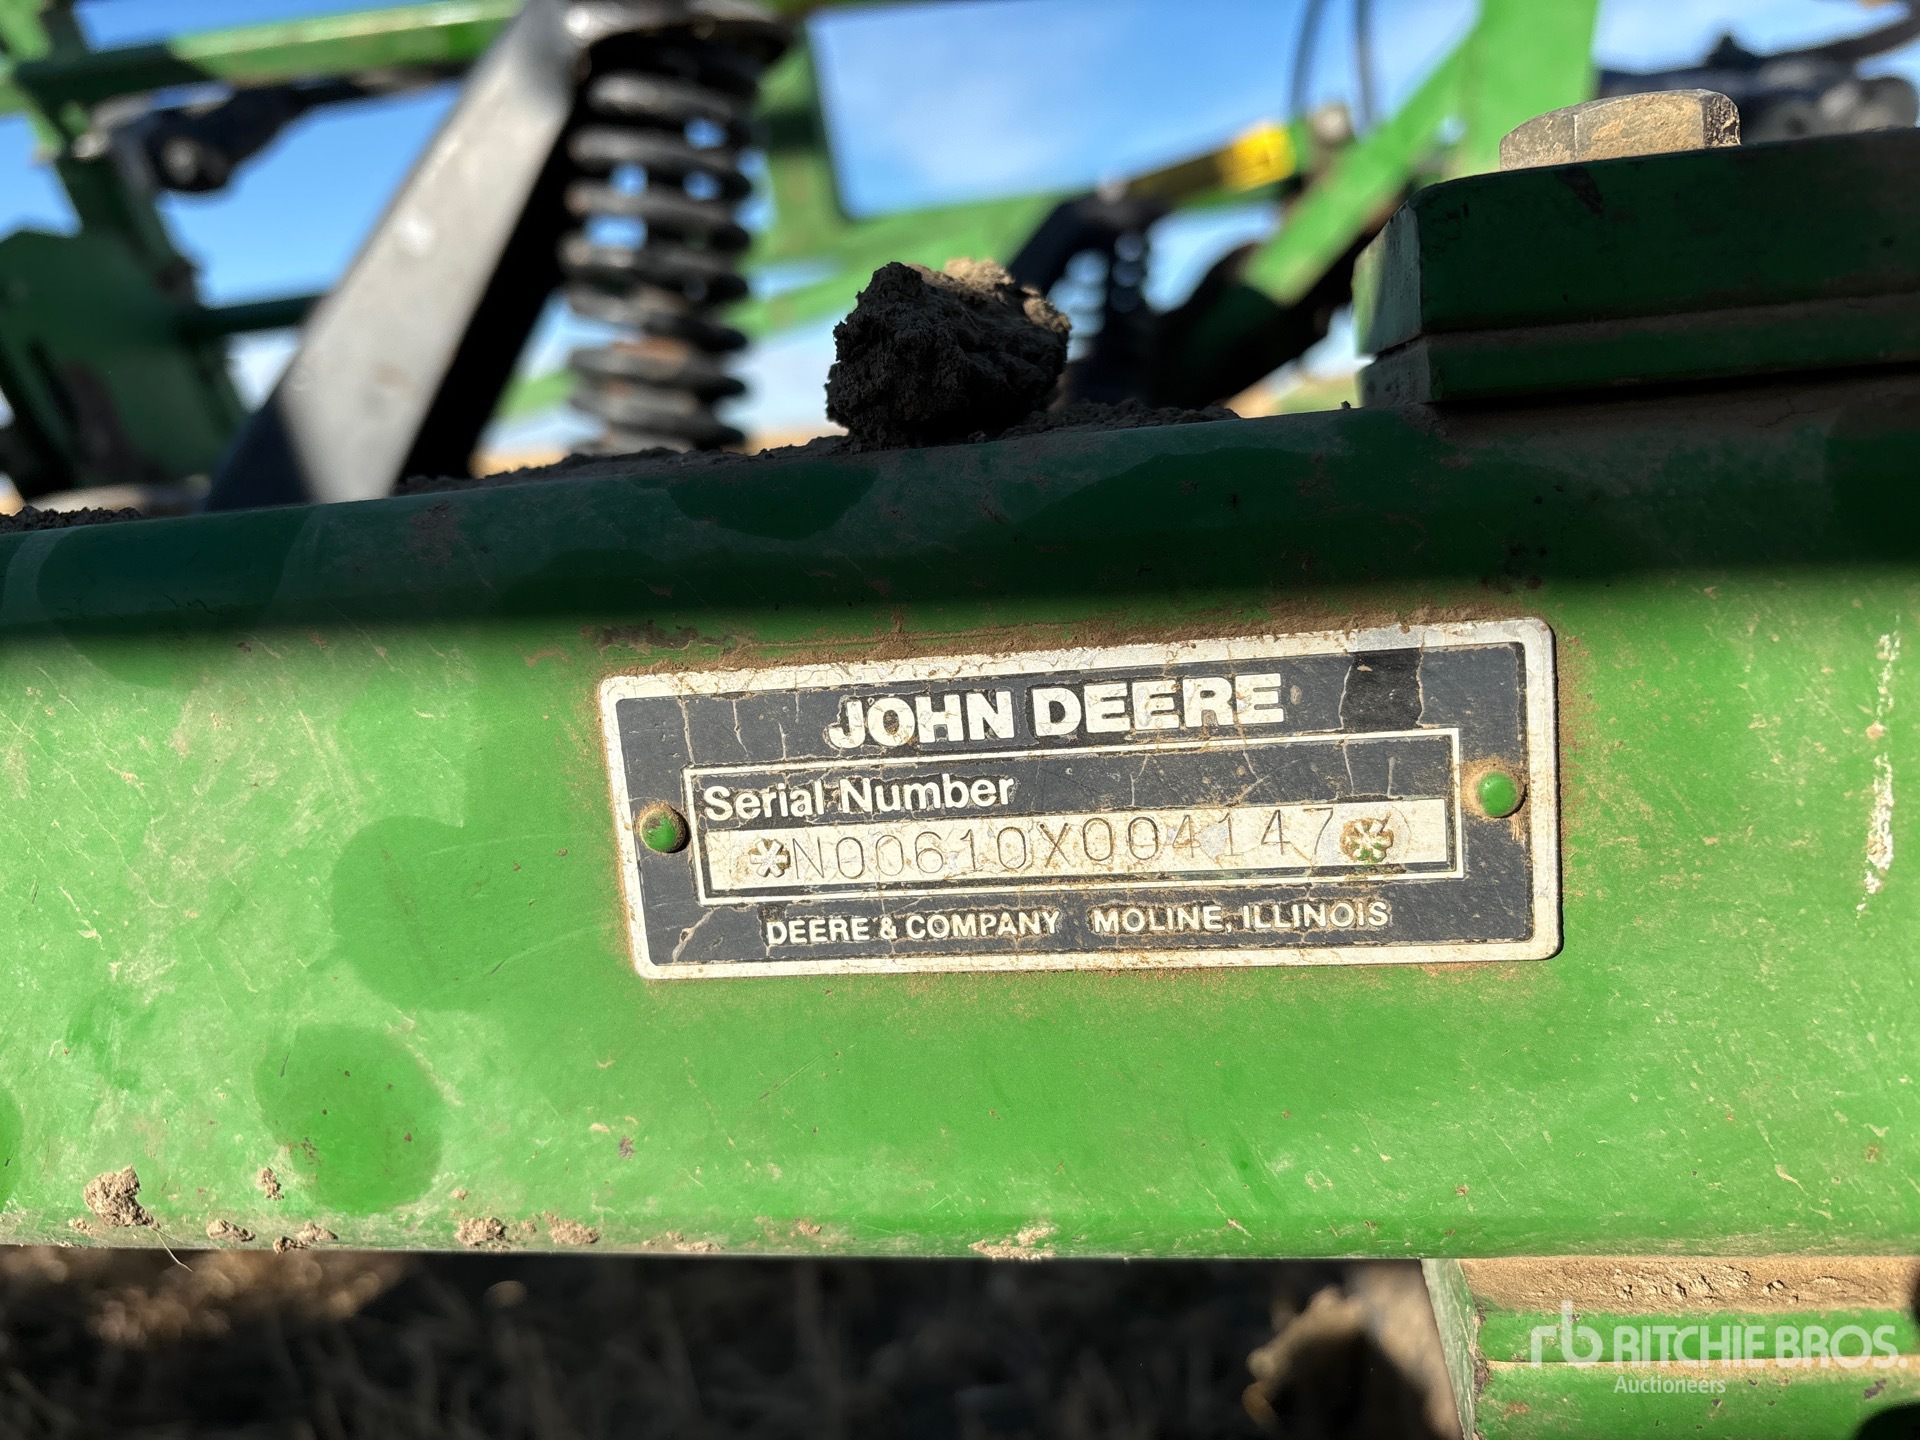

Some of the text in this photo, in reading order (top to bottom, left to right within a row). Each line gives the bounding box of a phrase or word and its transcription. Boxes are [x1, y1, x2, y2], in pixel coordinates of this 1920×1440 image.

[827, 672, 1286, 750] JOHN DEERE
[703, 773, 1015, 822] Serial Number
[766, 916, 870, 946] DEERE
[880, 915, 898, 942] &
[905, 911, 1060, 941] COMPANY
[1243, 900, 1390, 929] ILLINOIS
